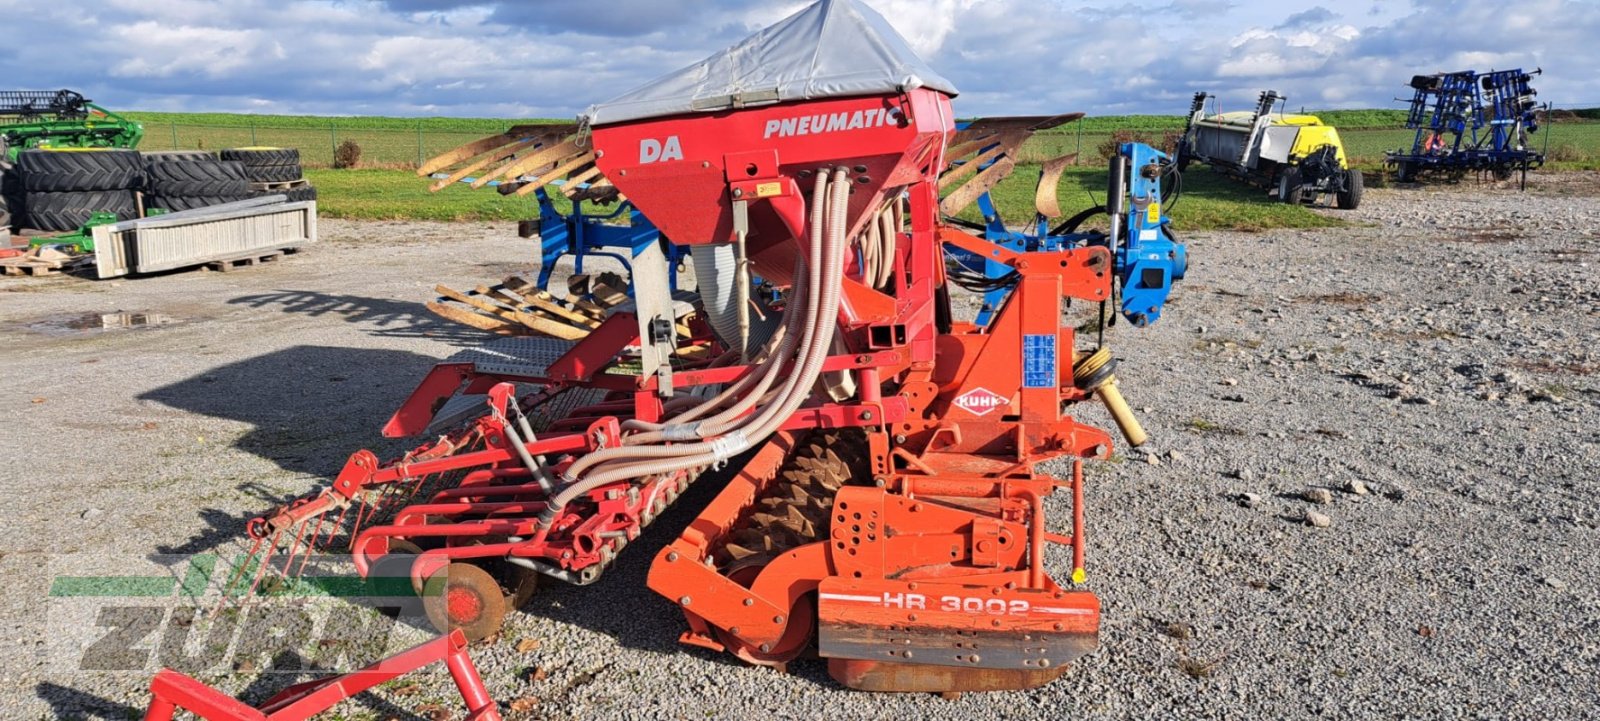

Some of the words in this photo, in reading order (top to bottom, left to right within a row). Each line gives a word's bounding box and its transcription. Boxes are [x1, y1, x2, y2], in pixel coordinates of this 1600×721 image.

[764, 107, 902, 139] PNEUMATIC
[639, 136, 684, 164] DA
[883, 592, 926, 610] HR
[941, 596, 1030, 615] 3002
